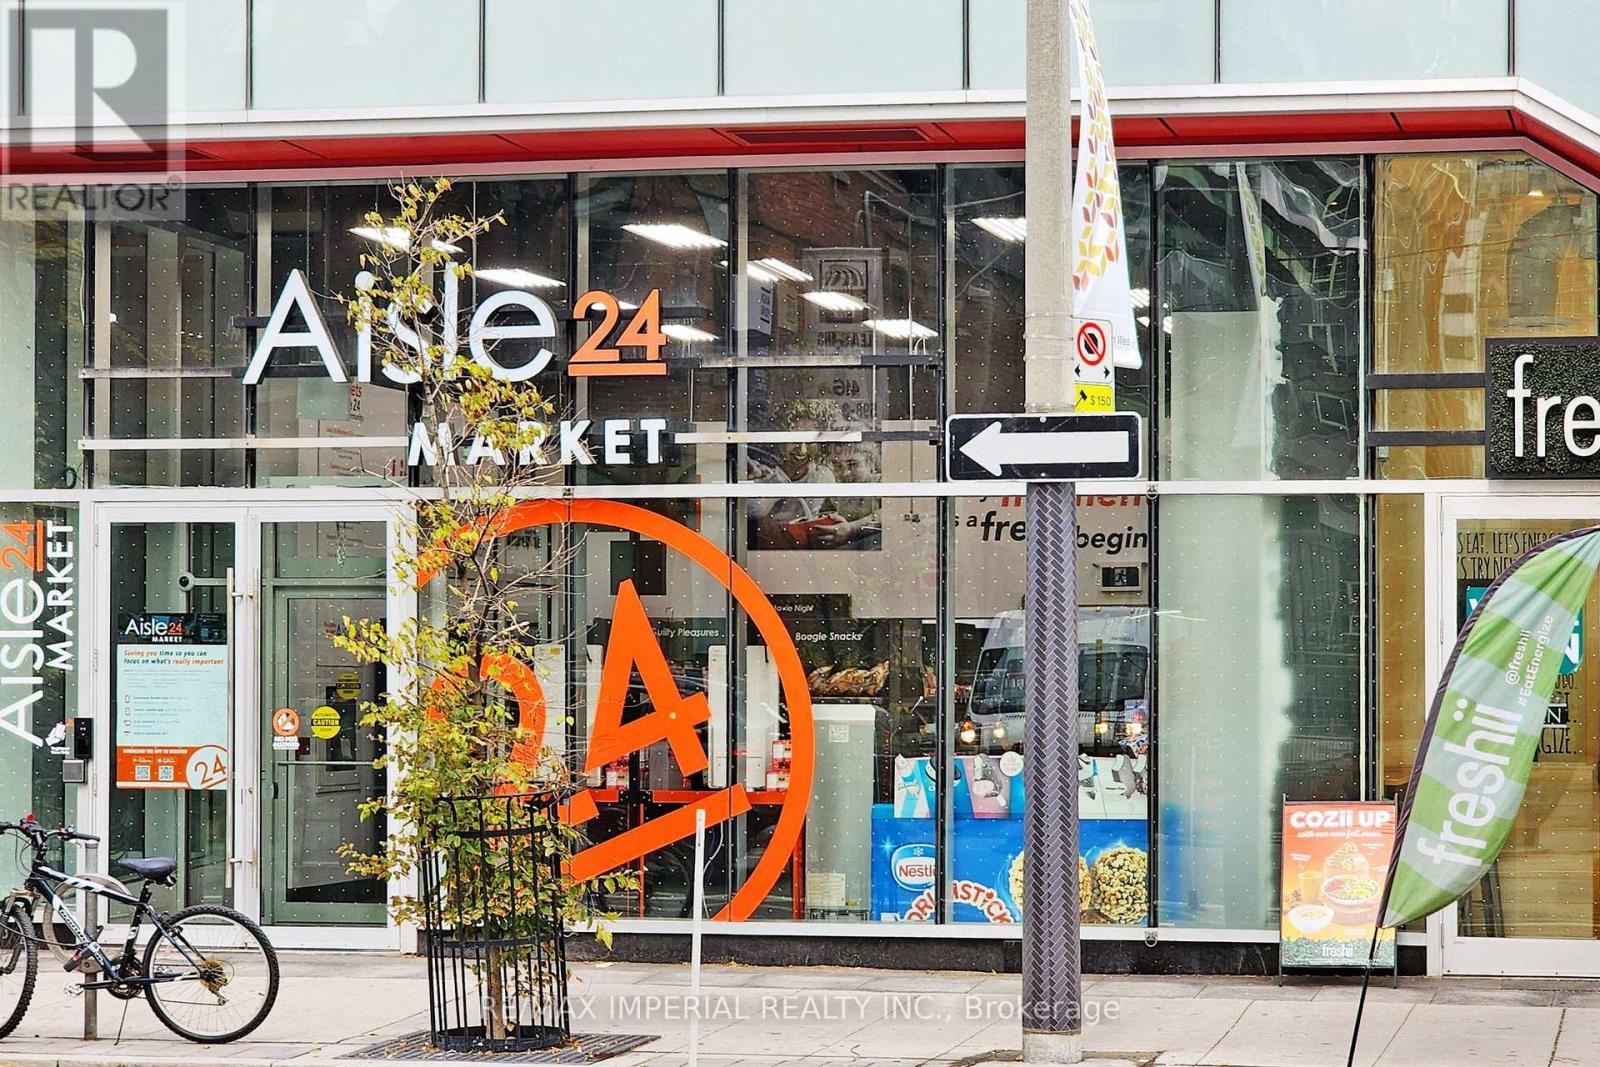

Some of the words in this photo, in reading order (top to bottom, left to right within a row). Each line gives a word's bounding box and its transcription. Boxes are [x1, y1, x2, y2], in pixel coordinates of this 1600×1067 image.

[242, 262, 558, 386] Aisle
[568, 288, 668, 376] 24
[408, 417, 668, 467] MARKET
[981, 510, 1026, 542] fre
[0, 519, 44, 573] 24
[1493, 532, 1520, 554] LET'S
[46, 519, 75, 671] MARKET
[794, 604, 814, 613] Night
[124, 616, 168, 636] Aisle
[168, 622, 184, 636] 24
[677, 626, 720, 638] Pleasures
[829, 631, 863, 641] Snacks
[152, 635, 184, 643] MARKET
[0, 577, 45, 748] Aisle
[192, 658, 225, 666] important
[1517, 615, 1554, 707] #EatEnergize
[1358, 809, 1392, 828] UP
